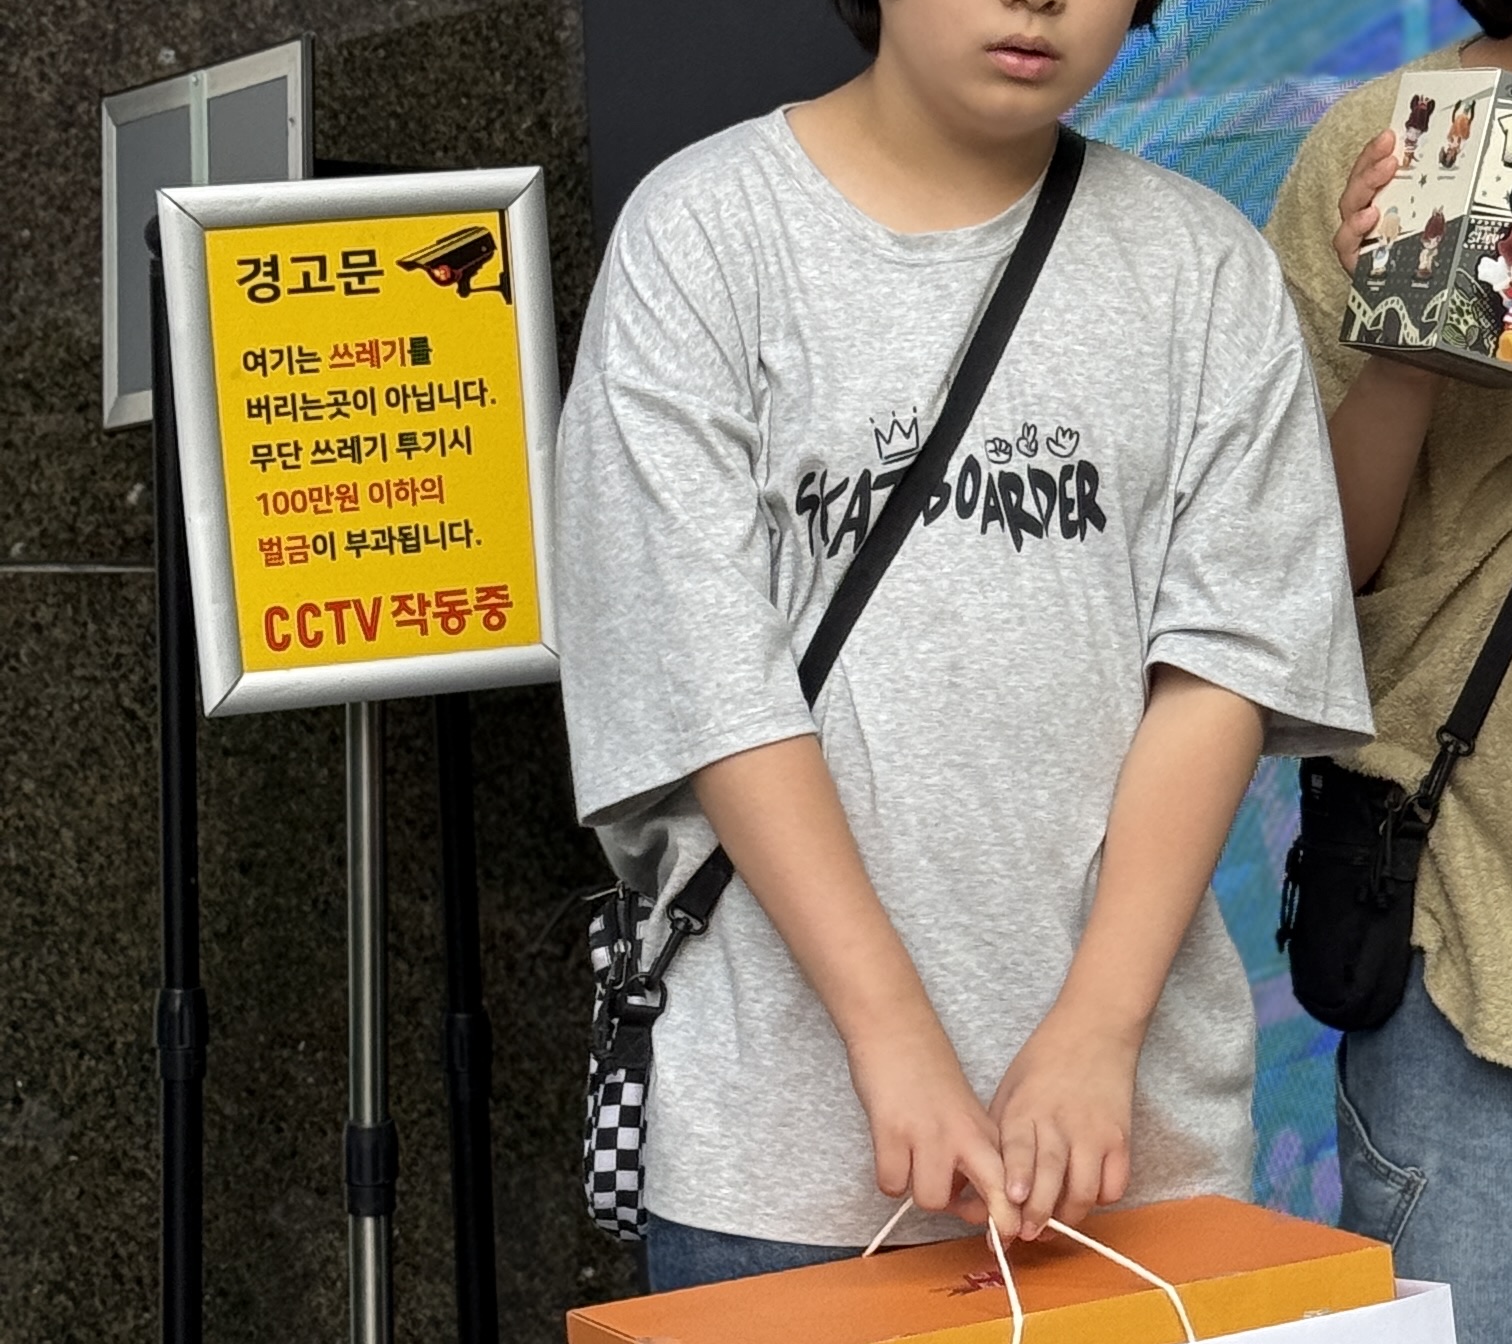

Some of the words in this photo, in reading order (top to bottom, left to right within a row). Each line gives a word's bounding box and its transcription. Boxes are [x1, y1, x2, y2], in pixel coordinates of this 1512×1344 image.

[236, 248, 385, 304] 경고문
[242, 345, 321, 378] 여기는
[328, 335, 433, 370] 쓰레기를
[246, 386, 378, 425] 버리는곳이
[385, 377, 497, 414] 아닙니다.
[250, 440, 302, 473] 무단
[310, 433, 388, 465] 쓰레기
[395, 425, 473, 460] 투기시
[256, 481, 361, 517] 100만원
[368, 474, 446, 508] 이하의
[257, 531, 337, 568] 벌금이
[344, 518, 482, 559] 부과됩니다.
[263, 596, 383, 652] CCTV
[390, 584, 514, 637] 작동중
